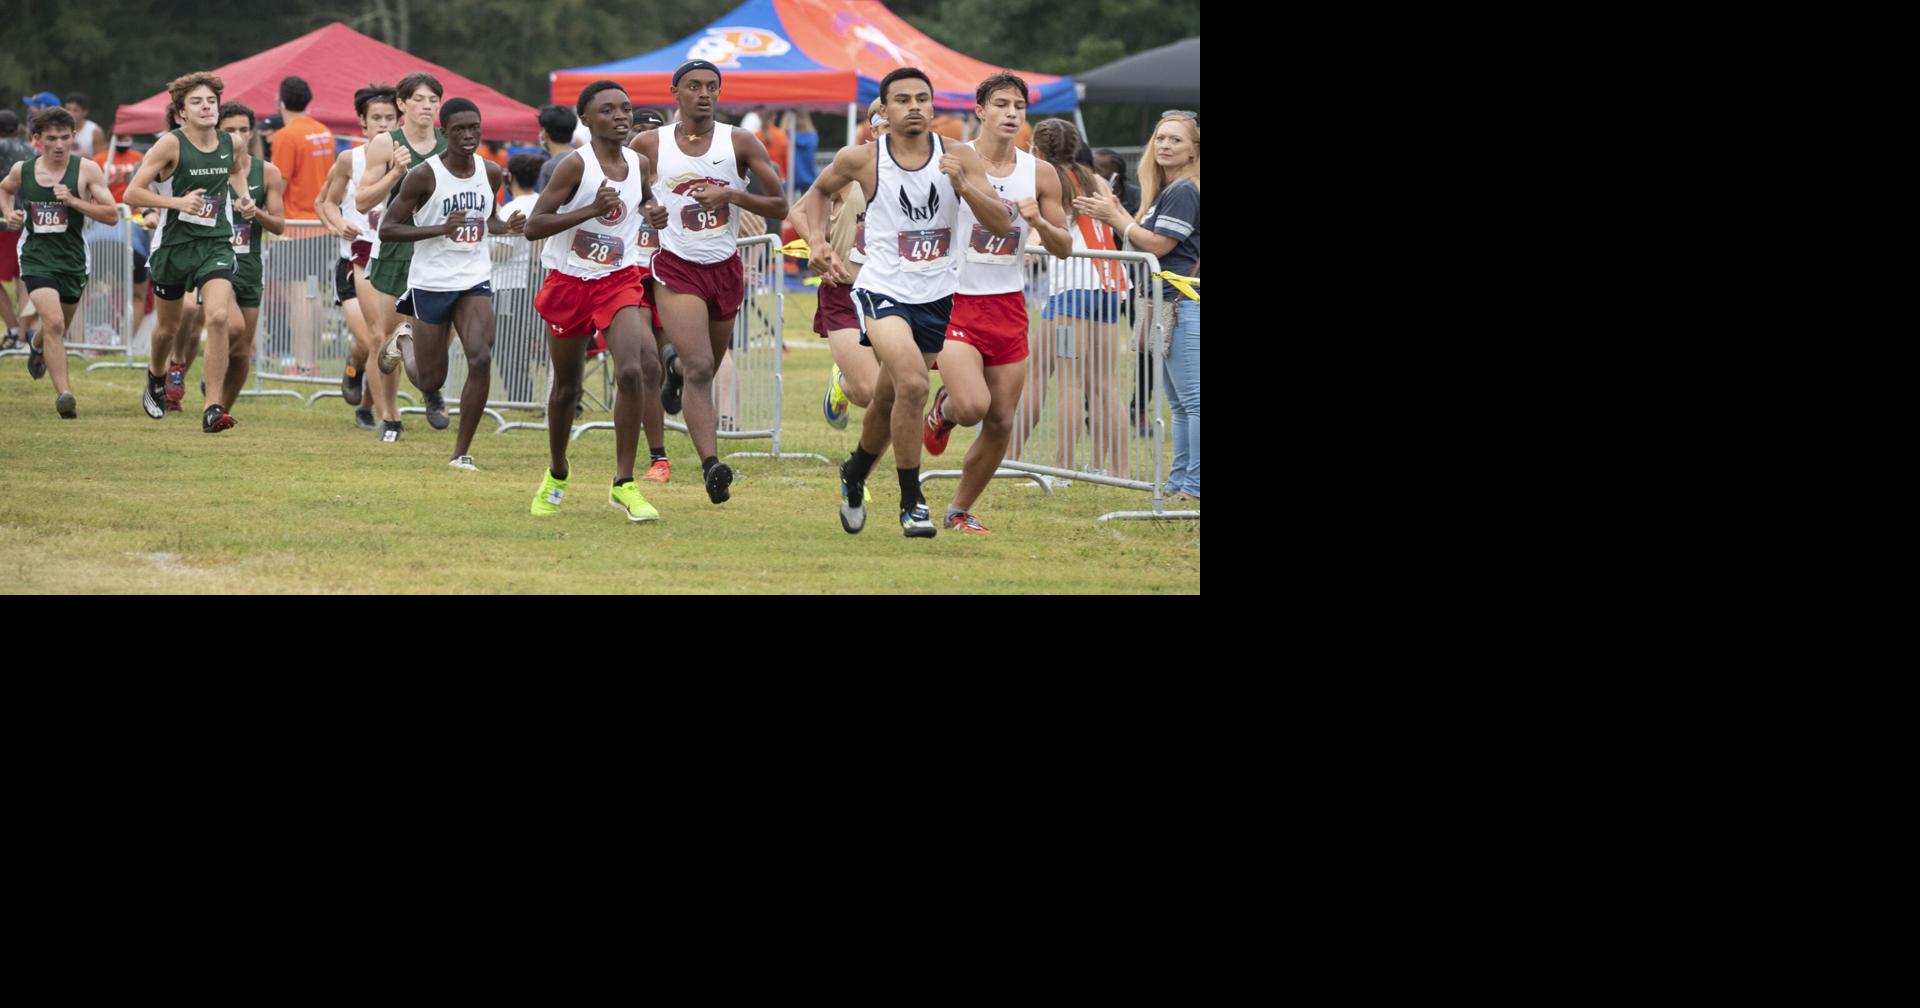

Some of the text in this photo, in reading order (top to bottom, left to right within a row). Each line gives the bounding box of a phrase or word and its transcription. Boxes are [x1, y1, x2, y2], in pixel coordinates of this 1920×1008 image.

[189, 167, 228, 176] WESLEYAN
[443, 191, 486, 217] DACULA
[37, 211, 60, 225] 786
[697, 210, 718, 229] 95
[455, 225, 479, 242] 213
[587, 242, 609, 262] 28
[911, 239, 940, 260] 494
